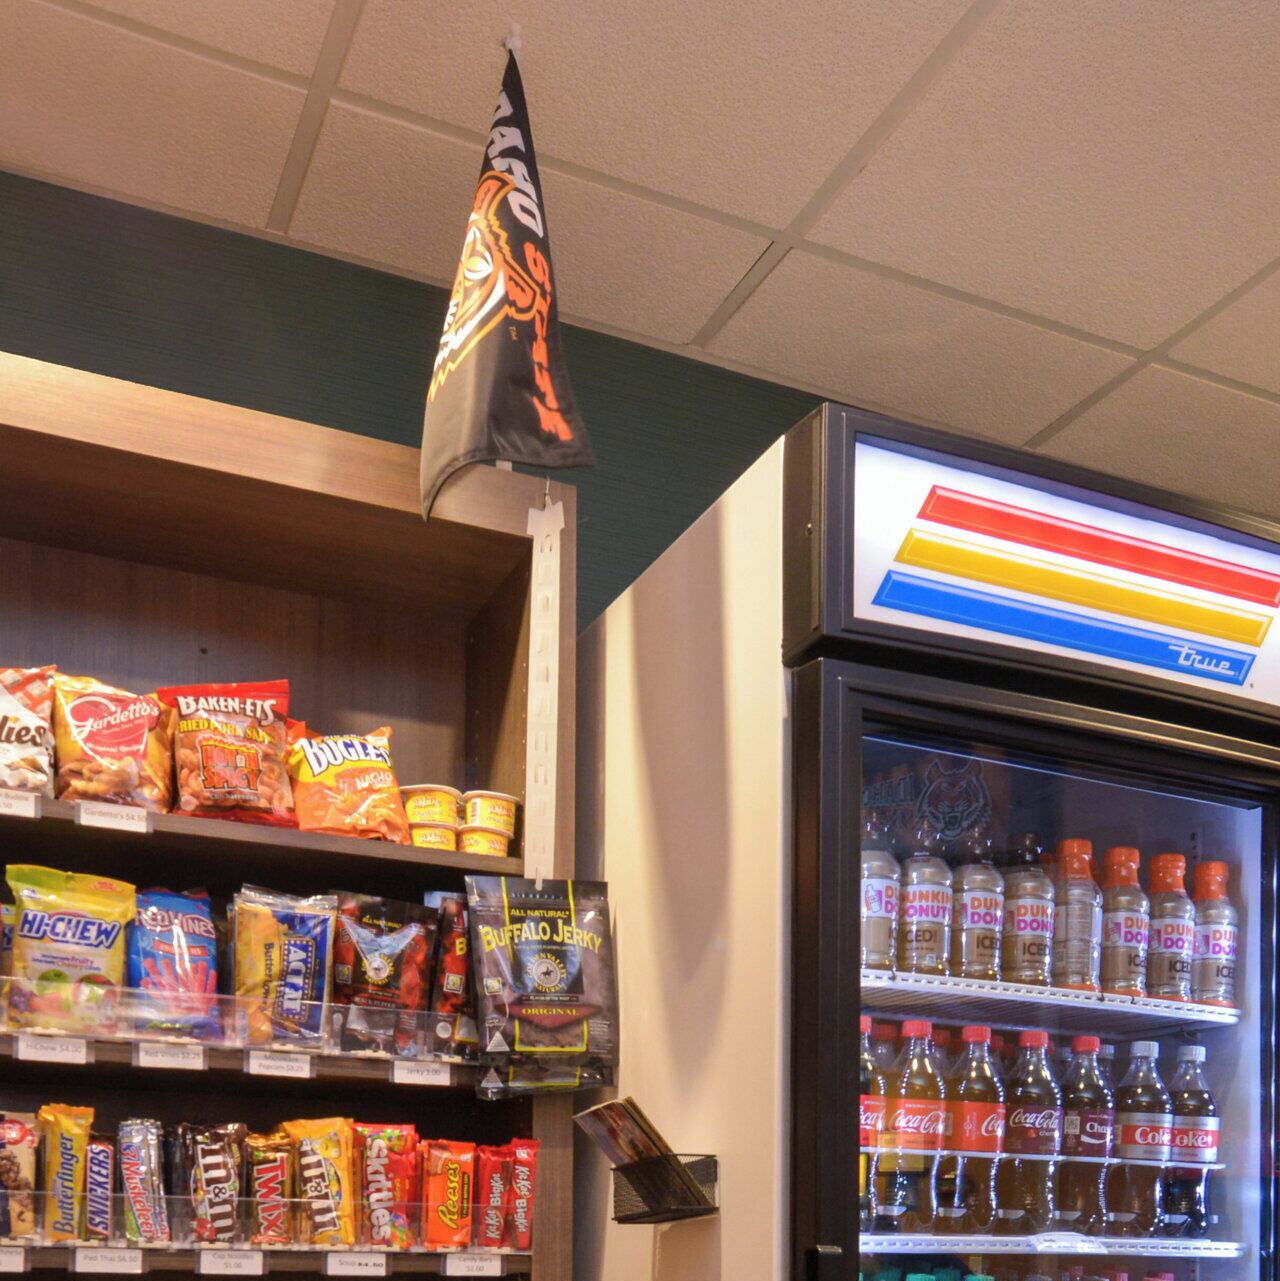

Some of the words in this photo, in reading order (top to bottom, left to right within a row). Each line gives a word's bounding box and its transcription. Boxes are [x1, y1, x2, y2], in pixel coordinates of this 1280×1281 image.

[1167, 643, 1237, 677] true
[69, 695, 162, 742] Gardetto's
[175, 695, 278, 727] BAKEN-ETS
[298, 736, 392, 777] BUGLES
[355, 771, 394, 791] NACHO
[19, 908, 121, 950] HI-CHEW
[510, 908, 526, 917] ALL
[479, 921, 552, 953] BUFFALO
[553, 918, 603, 954] JERKY
[262, 941, 276, 975] Butter
[285, 945, 308, 985] ACT
[522, 1006, 581, 1017] ORIGINAL
[257, 1063, 285, 1073] Popcorn
[285, 1063, 304, 1073] $3.25
[51, 1133, 81, 1236] Butterfinger
[87, 1145, 113, 1232] SNICKERS
[253, 1155, 287, 1237] TWIX
[365, 1138, 394, 1241] Skittles
[435, 1160, 462, 1229] Reese's
[83, 1254, 100, 1263] Pad
[101, 1254, 116, 1263] Thai
[226, 1252, 254, 1261] Noodles
[338, 1258, 356, 1268] Soup
